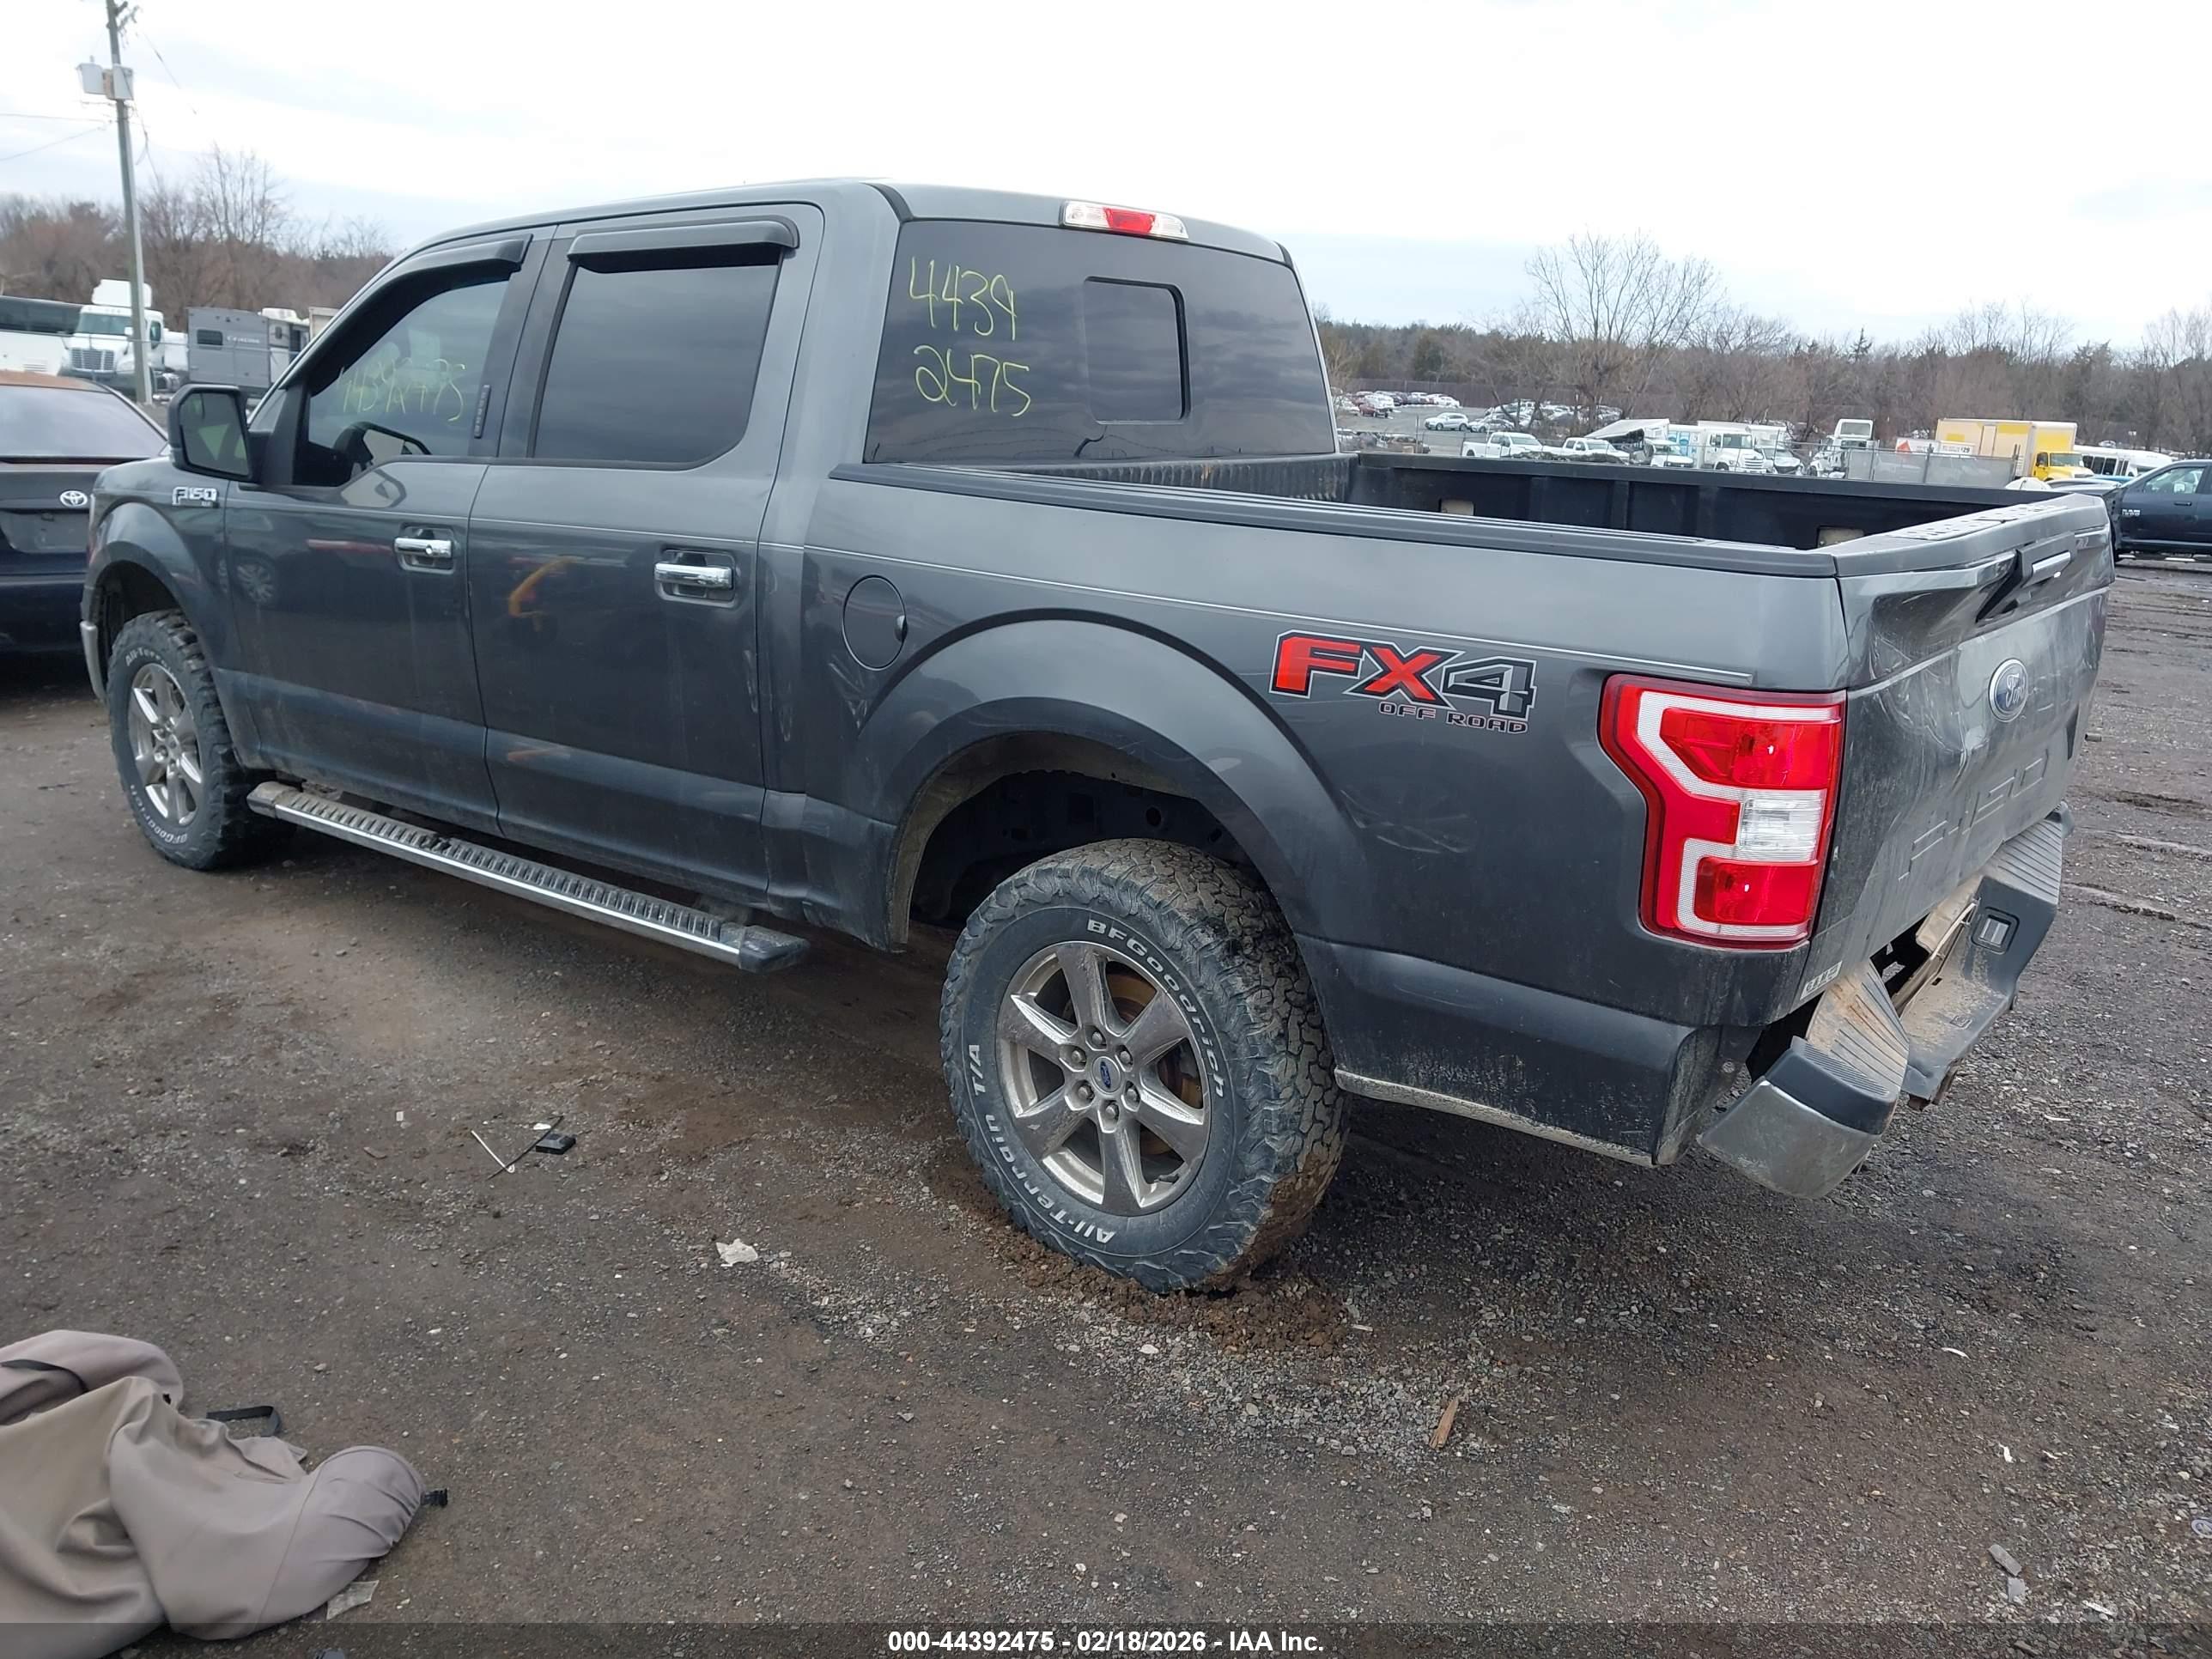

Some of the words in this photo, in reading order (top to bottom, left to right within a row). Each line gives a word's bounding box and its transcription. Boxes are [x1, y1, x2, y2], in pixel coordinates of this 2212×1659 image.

[908, 257, 1018, 341] 4439
[913, 344, 1030, 417] 2475
[1268, 629, 1537, 720] FX4
[1378, 702, 1437, 720] OFF
[1446, 711, 1528, 735] ROAD
[1086, 918, 1225, 1099] BFGoodrich
